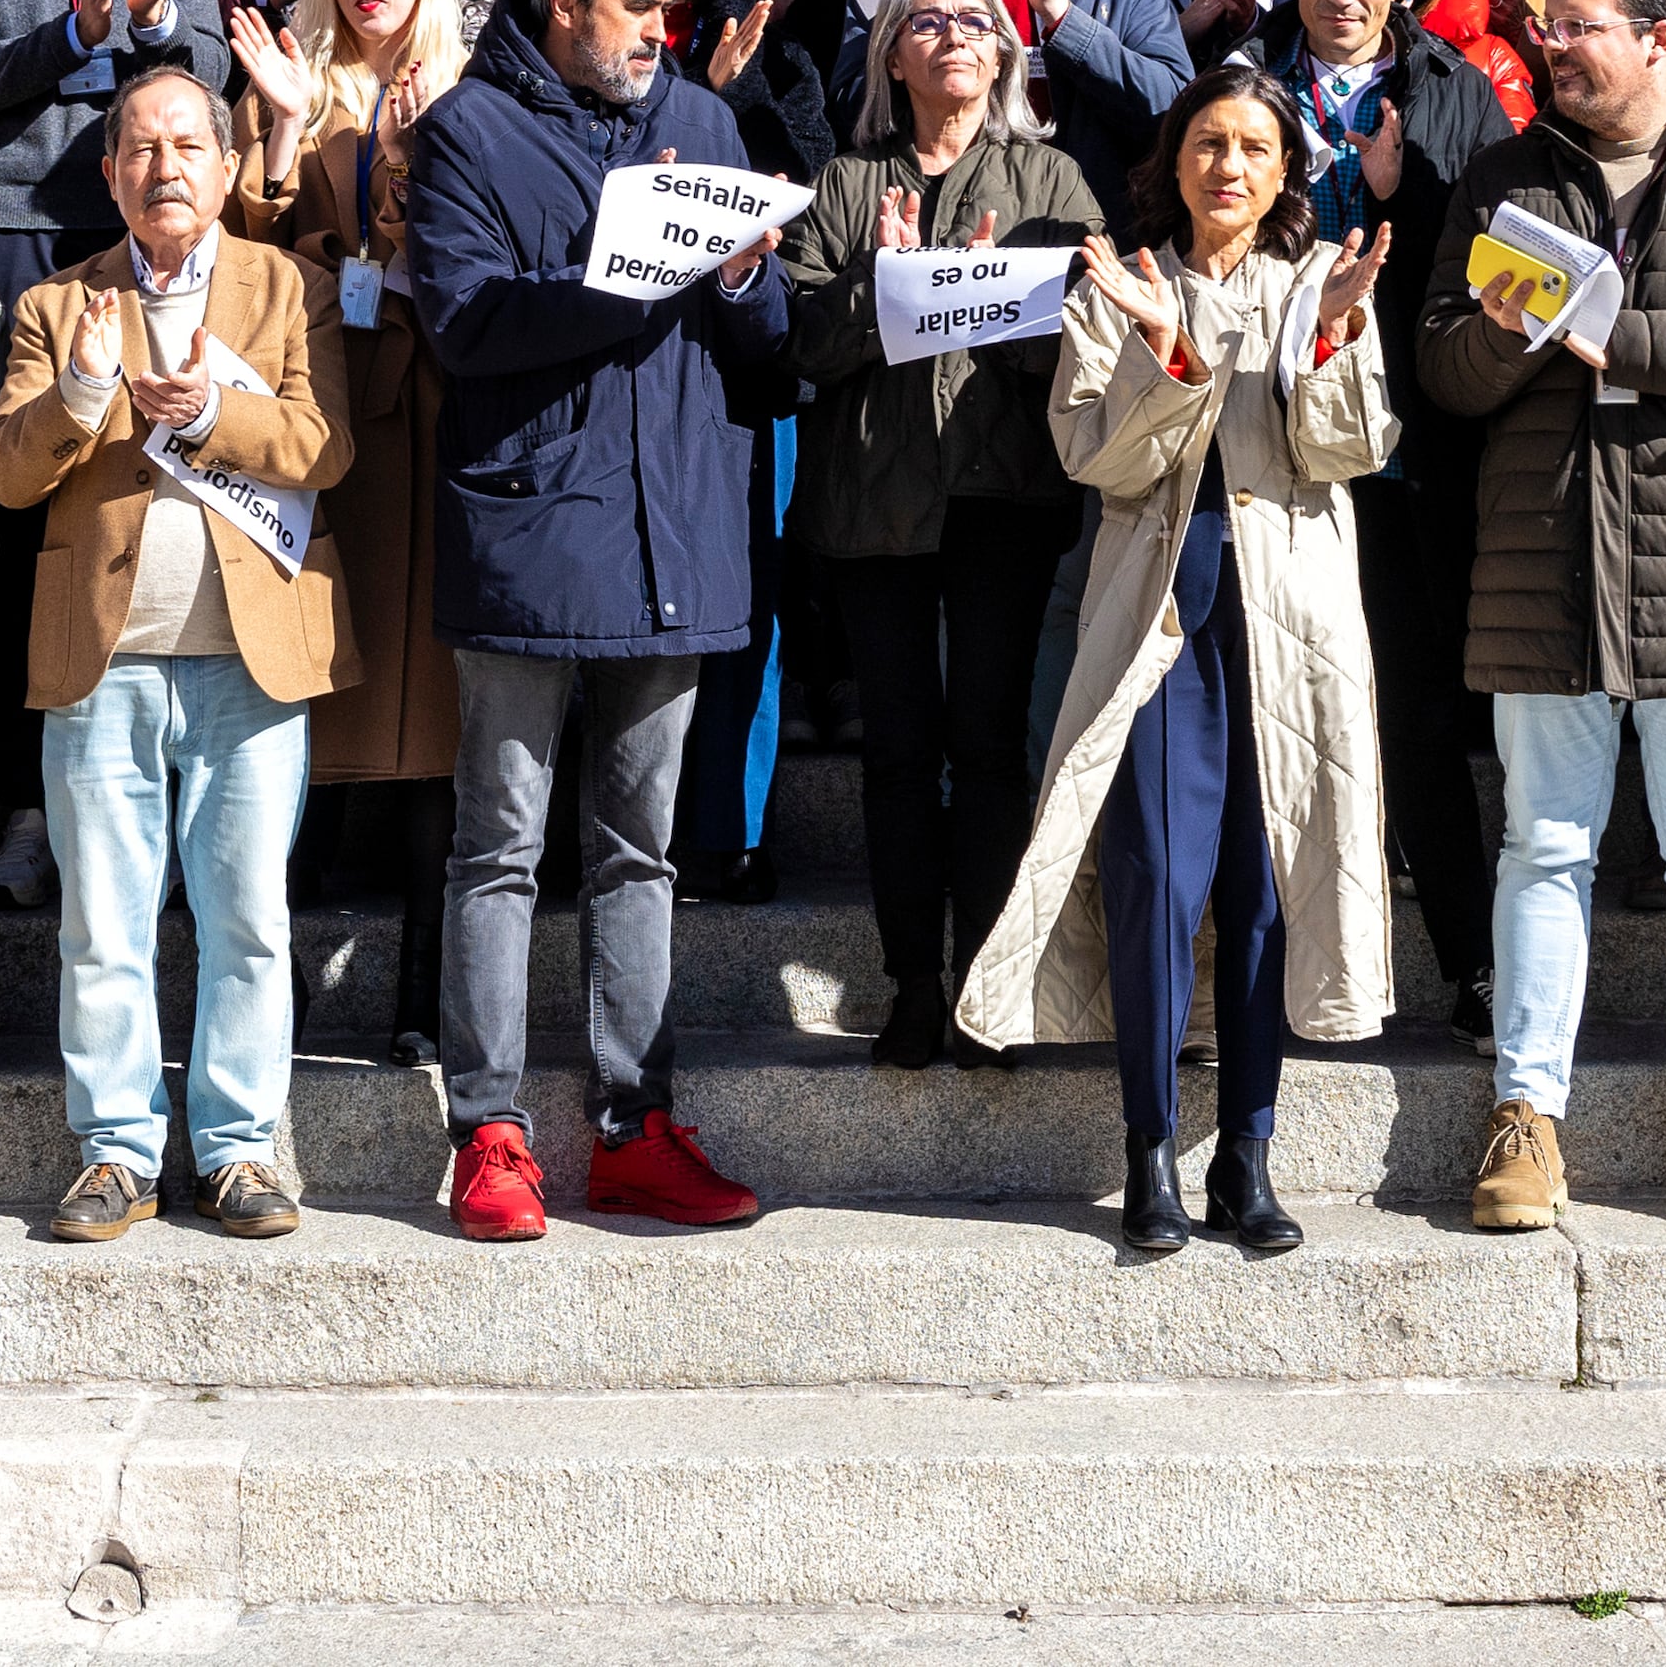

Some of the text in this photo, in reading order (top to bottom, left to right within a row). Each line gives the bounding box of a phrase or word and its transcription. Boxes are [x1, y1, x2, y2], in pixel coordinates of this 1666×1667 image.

[652, 174, 771, 218] Señalar
[662, 221, 736, 255] no es
[931, 261, 1008, 287] no es
[915, 300, 1022, 335] Señalar
